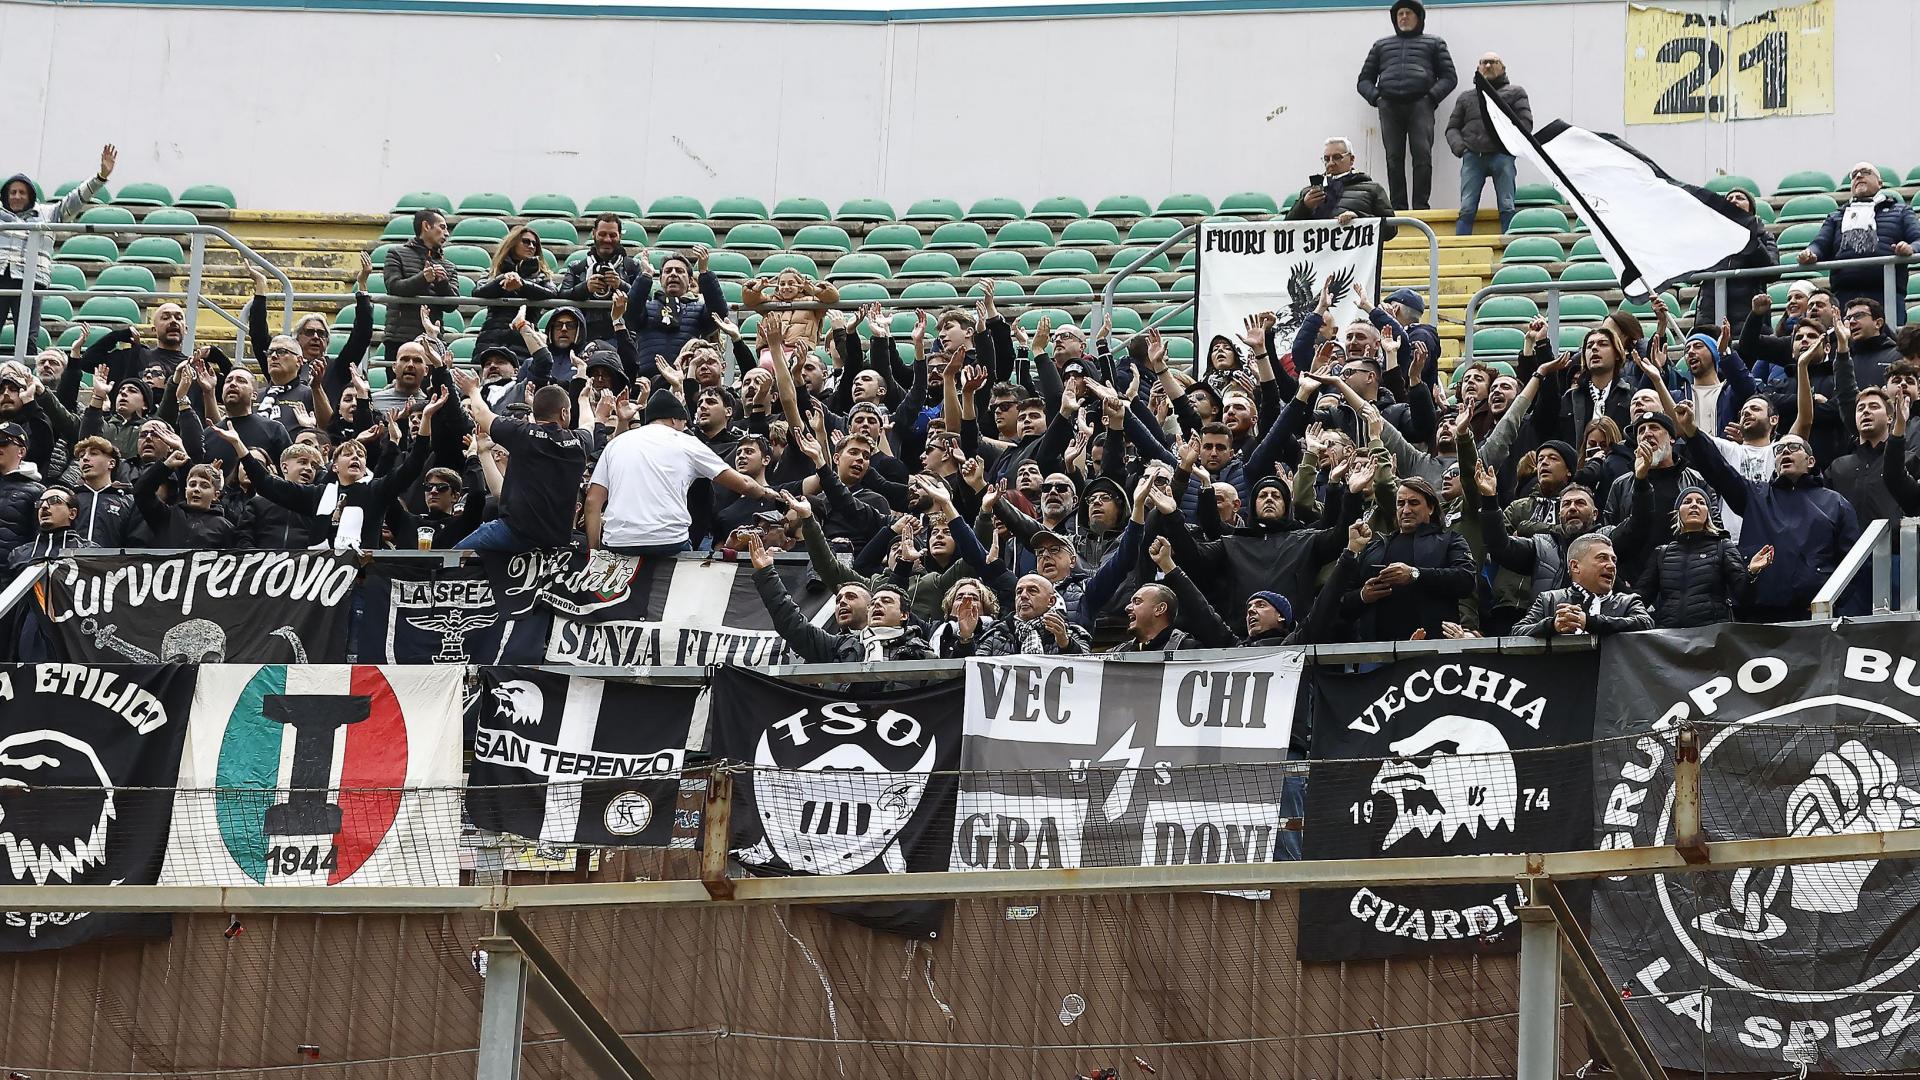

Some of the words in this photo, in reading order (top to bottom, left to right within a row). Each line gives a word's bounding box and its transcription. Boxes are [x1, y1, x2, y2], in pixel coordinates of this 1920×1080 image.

[1653, 31, 1788, 115] 21
[1205, 229, 1268, 256] FUORI
[1273, 229, 1295, 255] DI
[1303, 224, 1375, 254] SPEZIA
[400, 583, 428, 604] LA
[556, 620, 662, 667] SENZA
[35, 663, 168, 736] ETILICO
[976, 661, 1075, 724] VEC
[1176, 670, 1274, 730] CHI
[1347, 664, 1548, 735] VECCHIA
[475, 730, 531, 763] SAN
[541, 750, 674, 777] TERENZO
[1349, 800, 1374, 825] 19
[1522, 787, 1550, 811] 74
[265, 845, 339, 876] 1944
[957, 812, 1062, 870] GRA
[1154, 821, 1273, 866] DONI
[1635, 956, 1713, 1034] LA
